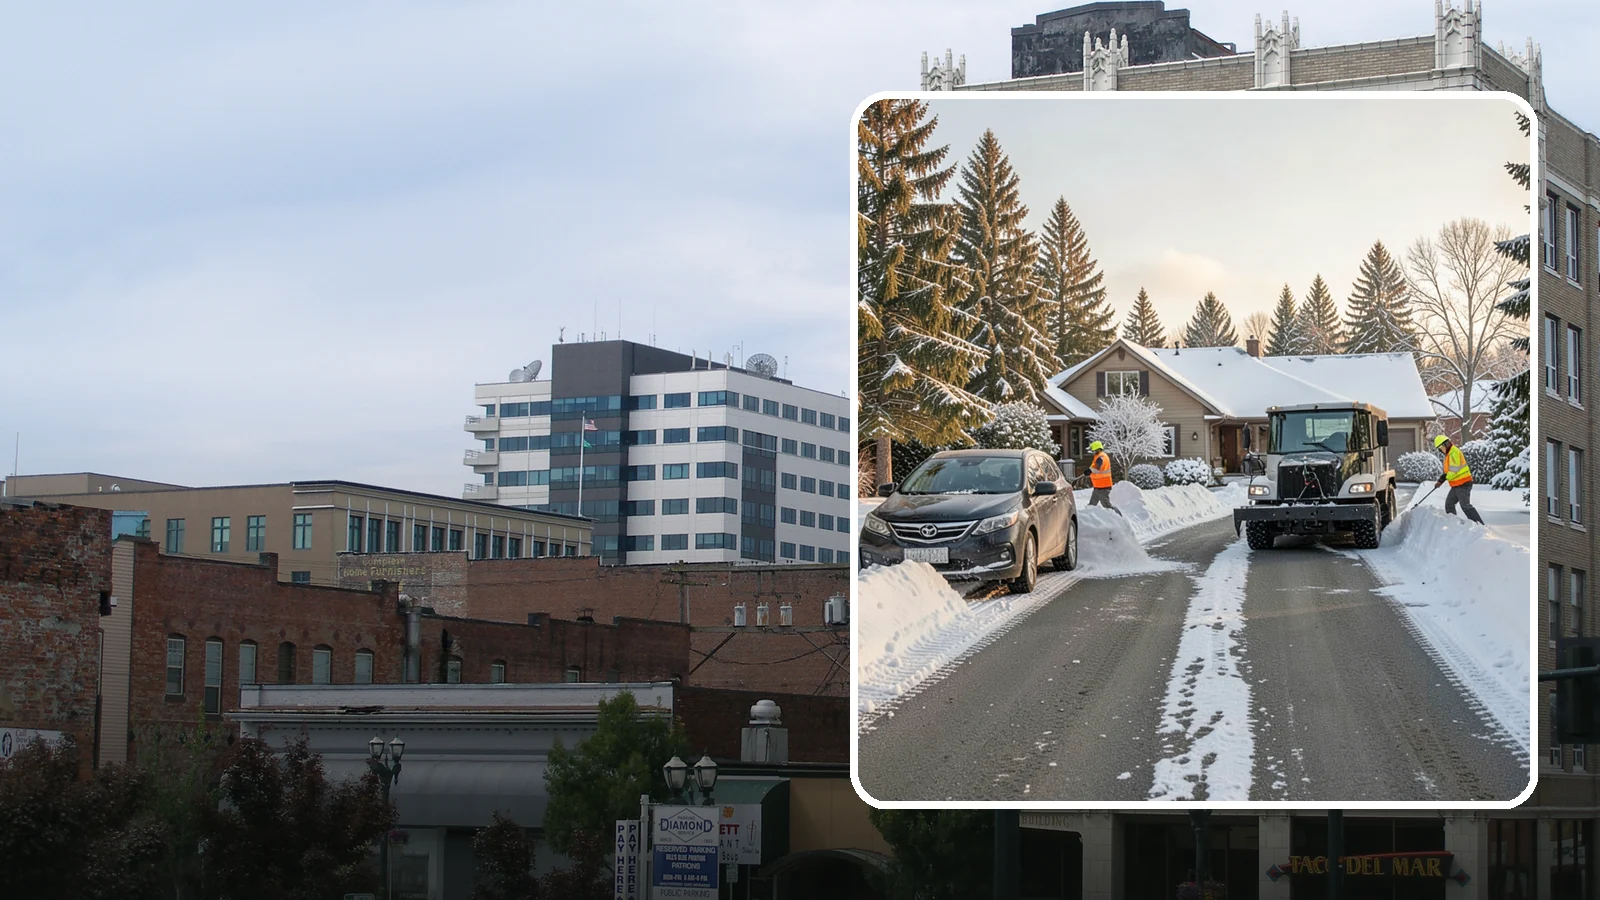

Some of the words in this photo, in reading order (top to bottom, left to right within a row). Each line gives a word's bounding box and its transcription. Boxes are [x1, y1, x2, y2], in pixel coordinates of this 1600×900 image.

[370, 566, 426, 577] Furnishers
[660, 818, 713, 833] DIAMOND
[1022, 815, 1070, 828] BUILDING
[617, 825, 625, 852] PAY
[628, 824, 637, 852] PAY
[656, 845, 688, 853] RESERVED
[689, 846, 716, 854] PARKING
[721, 851, 739, 863] Soup
[671, 861, 701, 870] PATRONS
[1346, 857, 1385, 876] DEL
[1391, 857, 1442, 877] MAR
[616, 856, 625, 893] HERE
[627, 856, 636, 893] HERE
[660, 888, 682, 897] PUBLIC
[683, 890, 710, 898] PARKING
